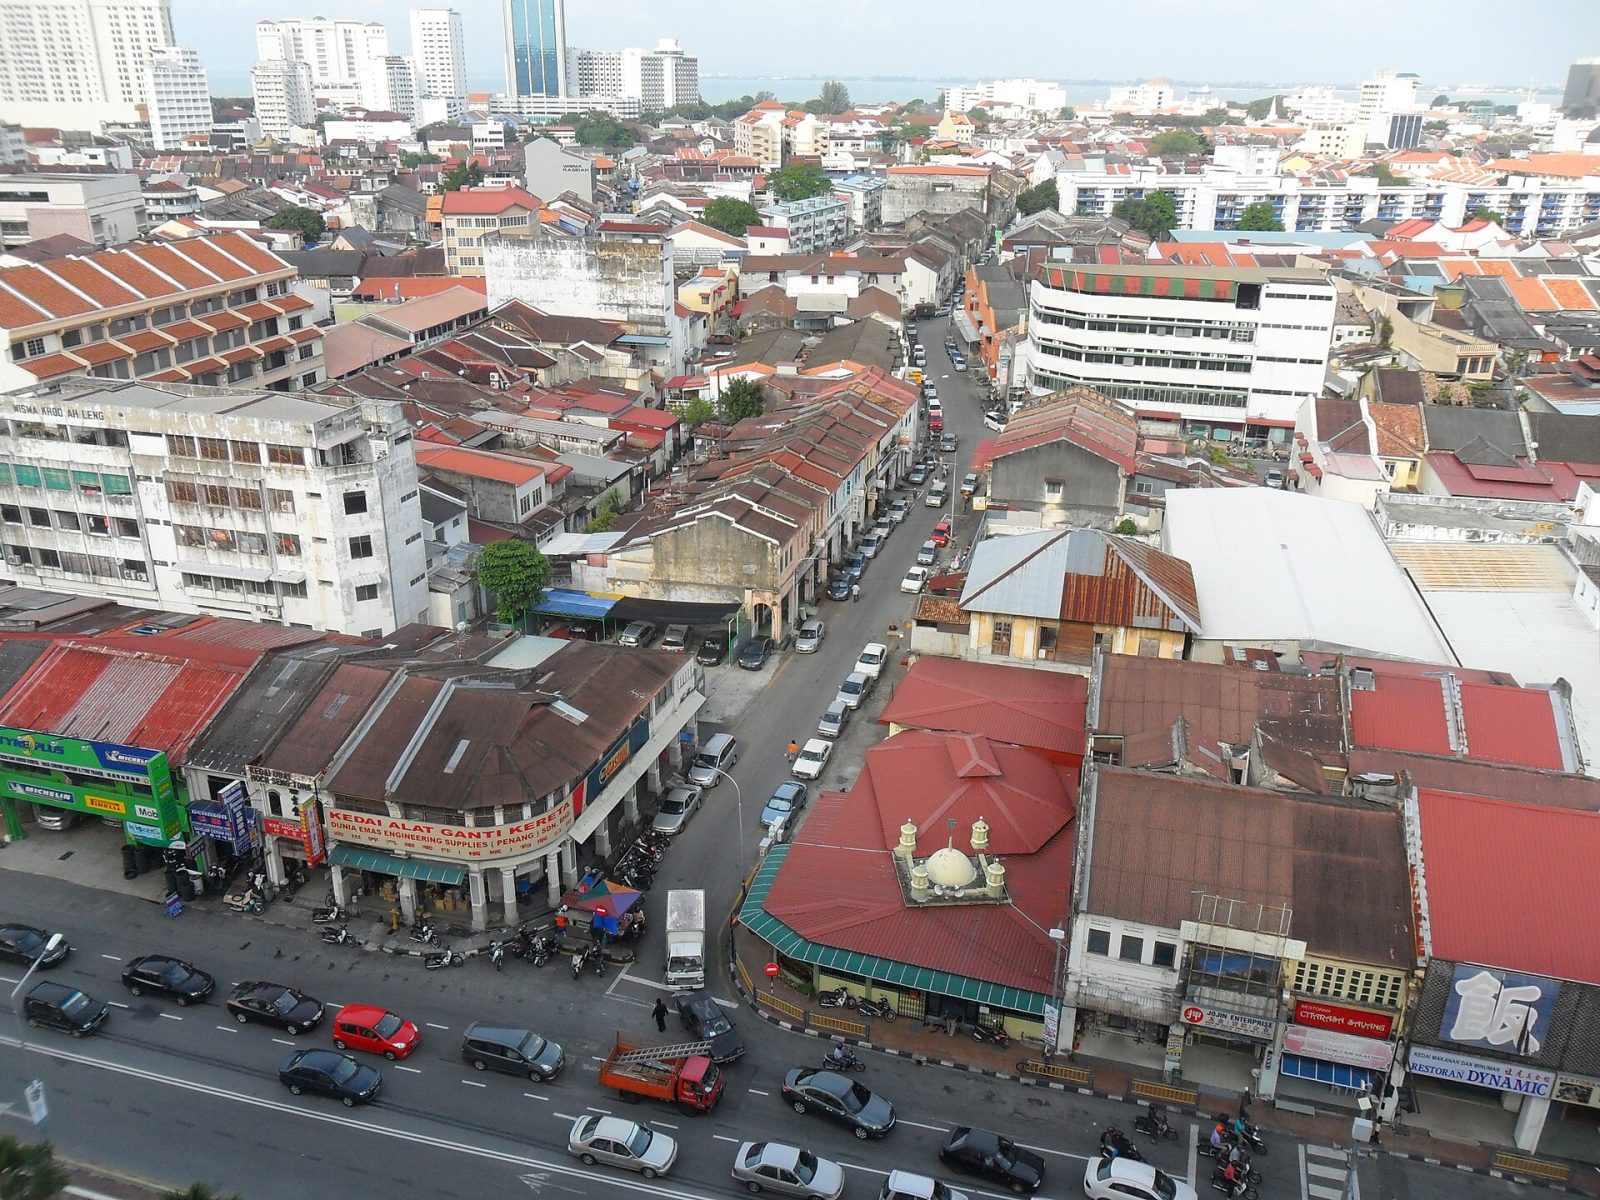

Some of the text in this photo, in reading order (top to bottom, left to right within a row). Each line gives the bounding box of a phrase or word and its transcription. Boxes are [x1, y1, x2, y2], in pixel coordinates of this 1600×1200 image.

[13, 404, 104, 420] WISMA KHOO AH LENG
[118, 755, 151, 765] MICHELI
[251, 775, 273, 784] HOCK
[25, 786, 71, 800] MICHELIN
[90, 798, 120, 811] PIRELLI
[329, 801, 570, 839] KEDAI ALAT GANTI KERETA
[331, 822, 357, 832] DUNIA
[359, 826, 382, 836] EMAS
[384, 830, 442, 844] ENGINEERING
[444, 839, 488, 848] SUPPLIES
[497, 833, 534, 846] PENANG
[1301, 1004, 1331, 1013] RESTORAN
[1450, 971, 1541, 1056] 飯
[1207, 1010, 1227, 1020] JOJIN
[1230, 1014, 1273, 1028] ENTERPRISE
[1347, 1018, 1386, 1032] SAYANG
[1432, 1054, 1460, 1065] MAKANAN
[1474, 1063, 1500, 1072] MINUMAN
[1411, 1062, 1548, 1096] RESTORAN DYNAMIC
